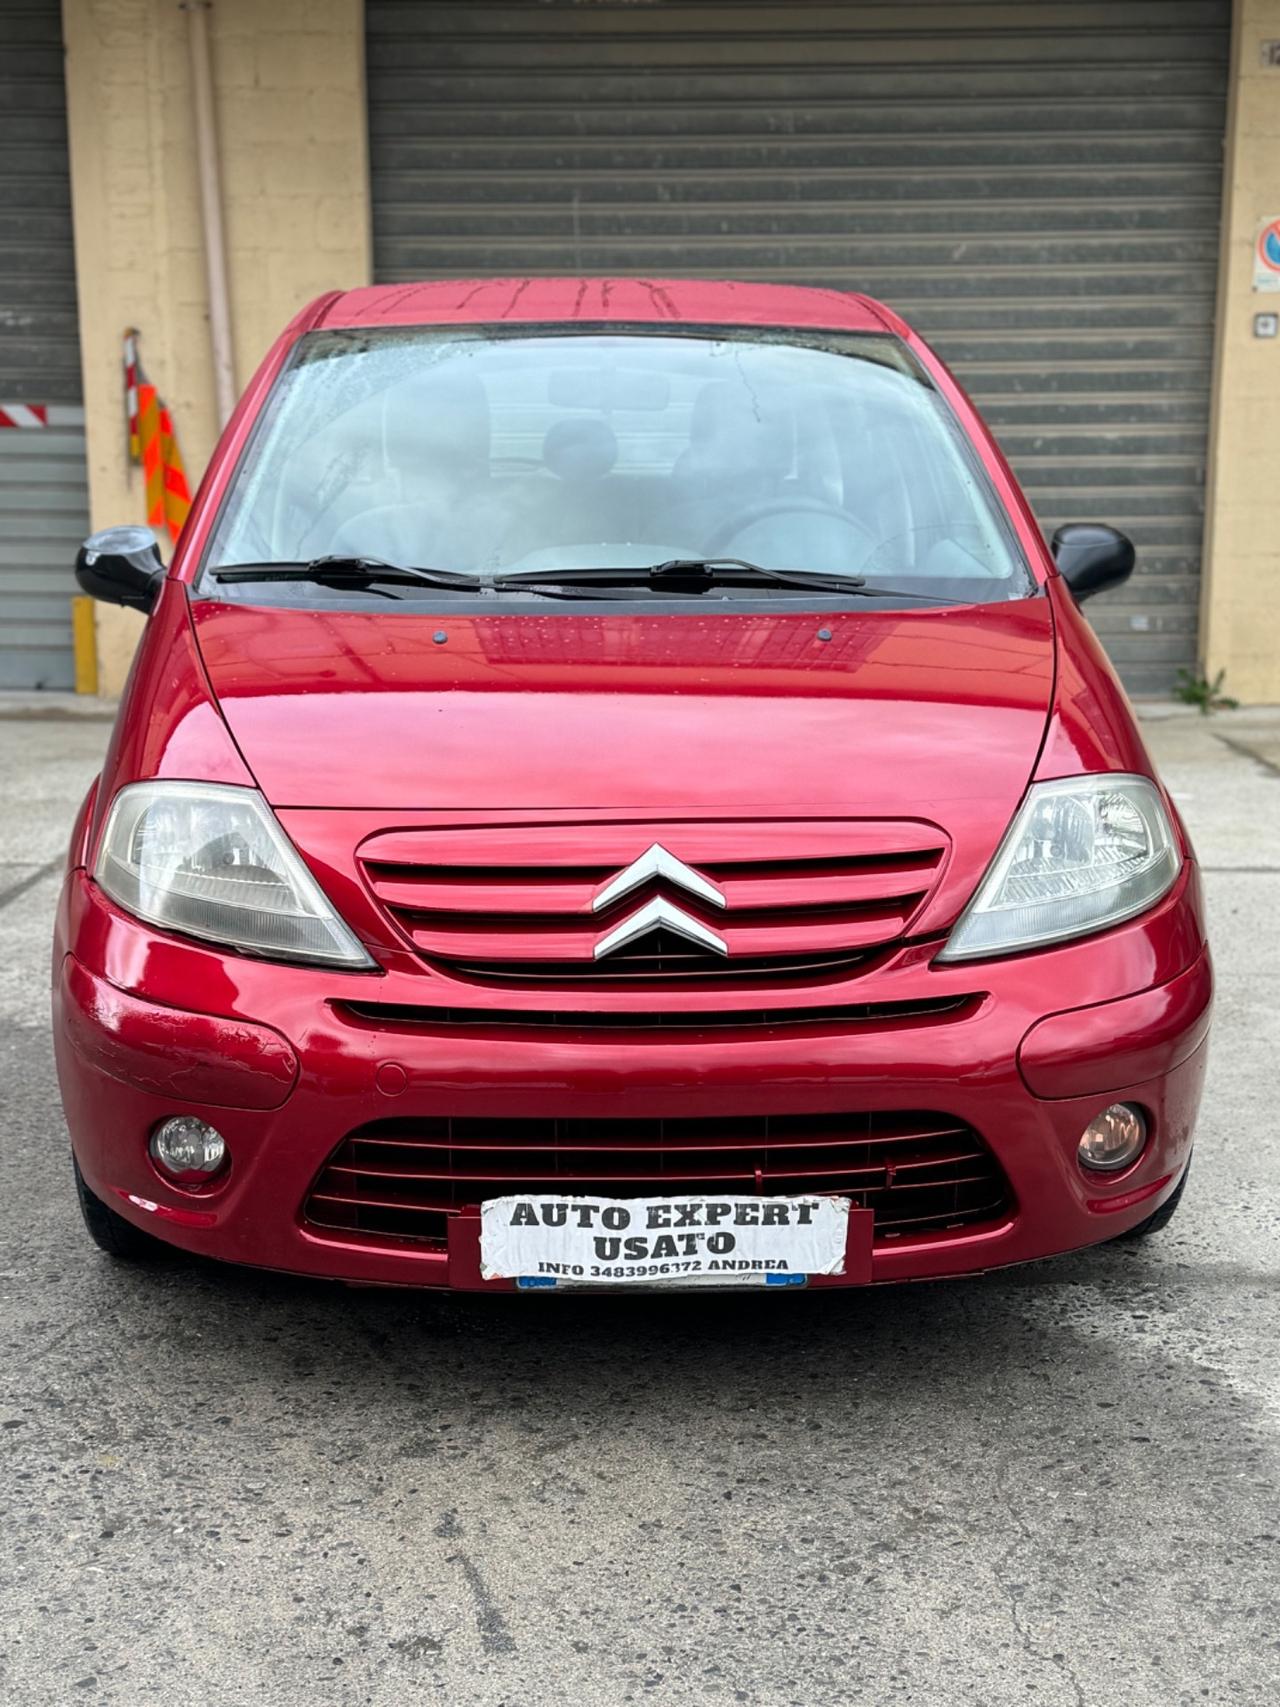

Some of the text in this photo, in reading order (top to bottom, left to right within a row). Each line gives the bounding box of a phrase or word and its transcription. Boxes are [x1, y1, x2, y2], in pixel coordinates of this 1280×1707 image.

[509, 1202, 820, 1231] AUTO EXPERT
[593, 1231, 736, 1261] USATO
[538, 1259, 789, 1278] INFO 3483996372 ANDREA
